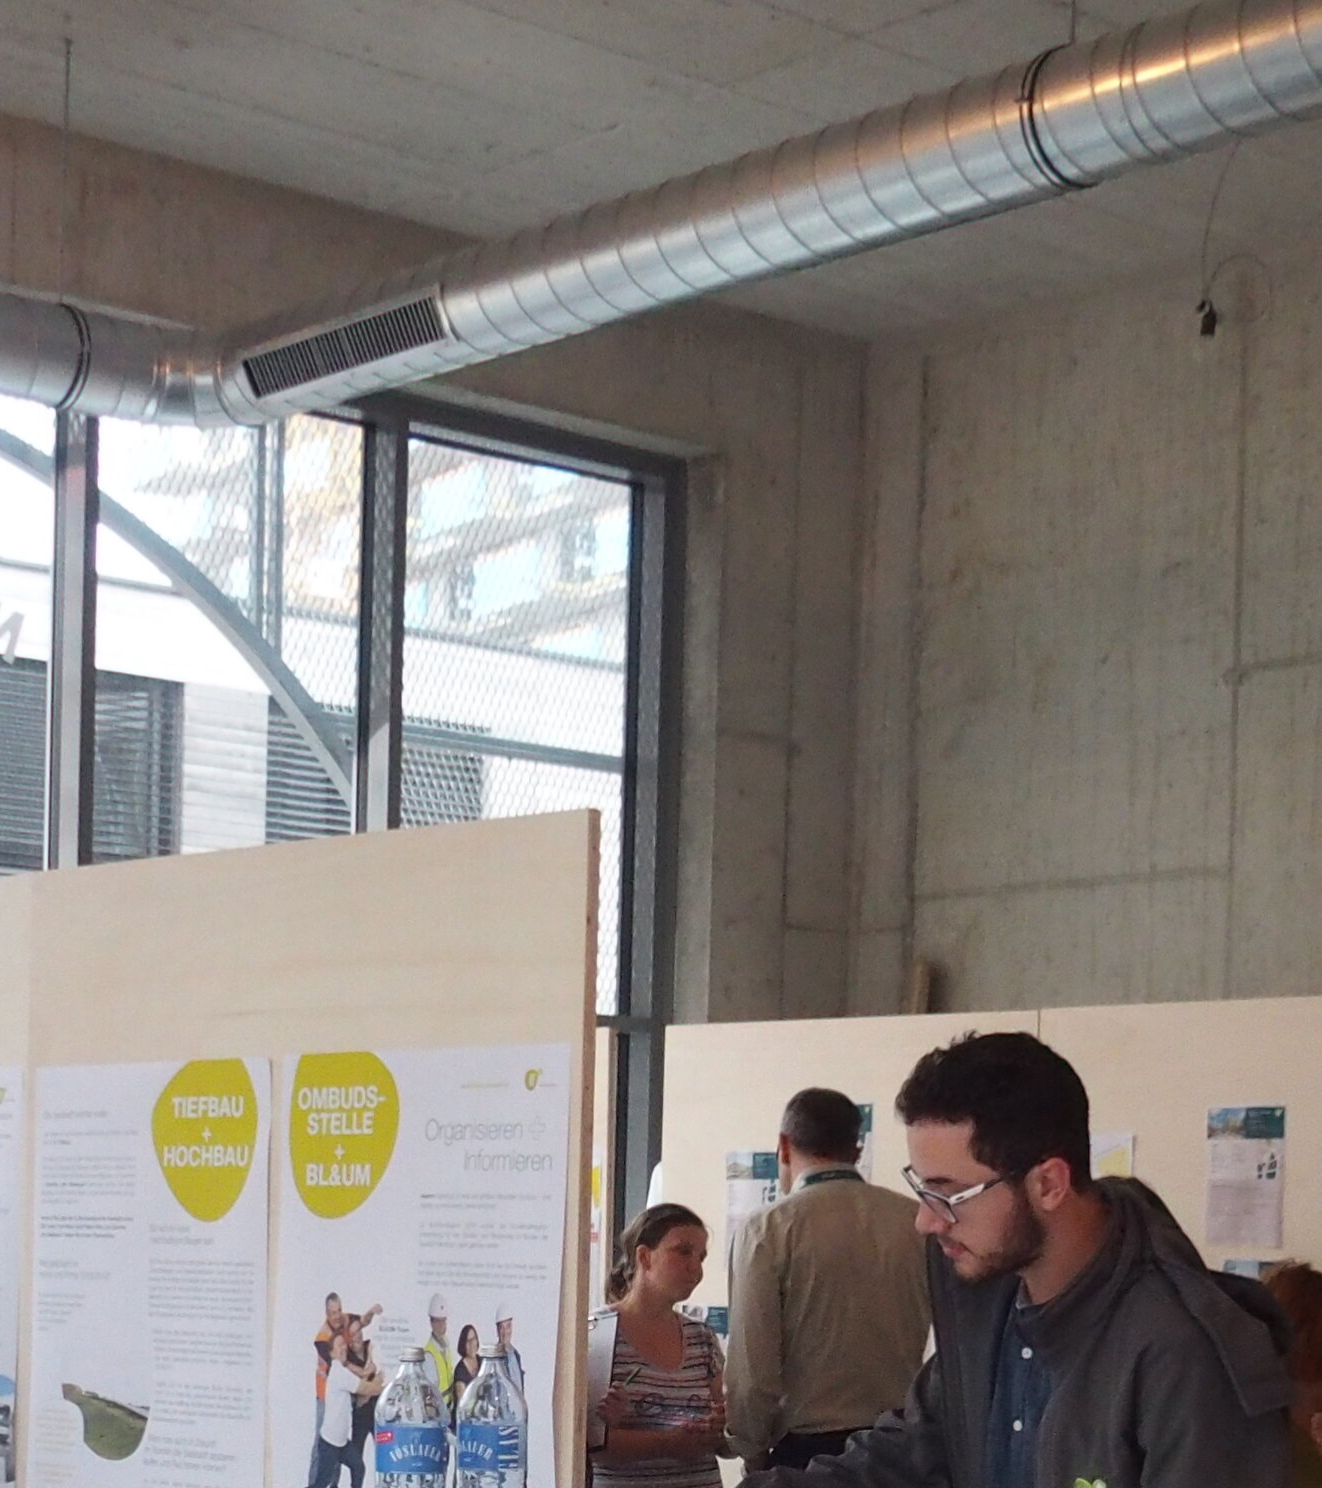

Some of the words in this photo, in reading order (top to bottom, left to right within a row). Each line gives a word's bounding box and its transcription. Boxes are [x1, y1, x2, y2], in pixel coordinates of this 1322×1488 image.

[171, 1095, 245, 1119] TIEFBAU
[297, 1085, 387, 1110] OMBUDS-
[201, 1126, 213, 1143] +
[306, 1111, 375, 1136] STELLE
[424, 1117, 524, 1147] Organisieren
[162, 1145, 250, 1168] HOCHBAU
[333, 1143, 346, 1161] +
[463, 1148, 554, 1173] Informieren
[305, 1163, 372, 1187] BL&UM
